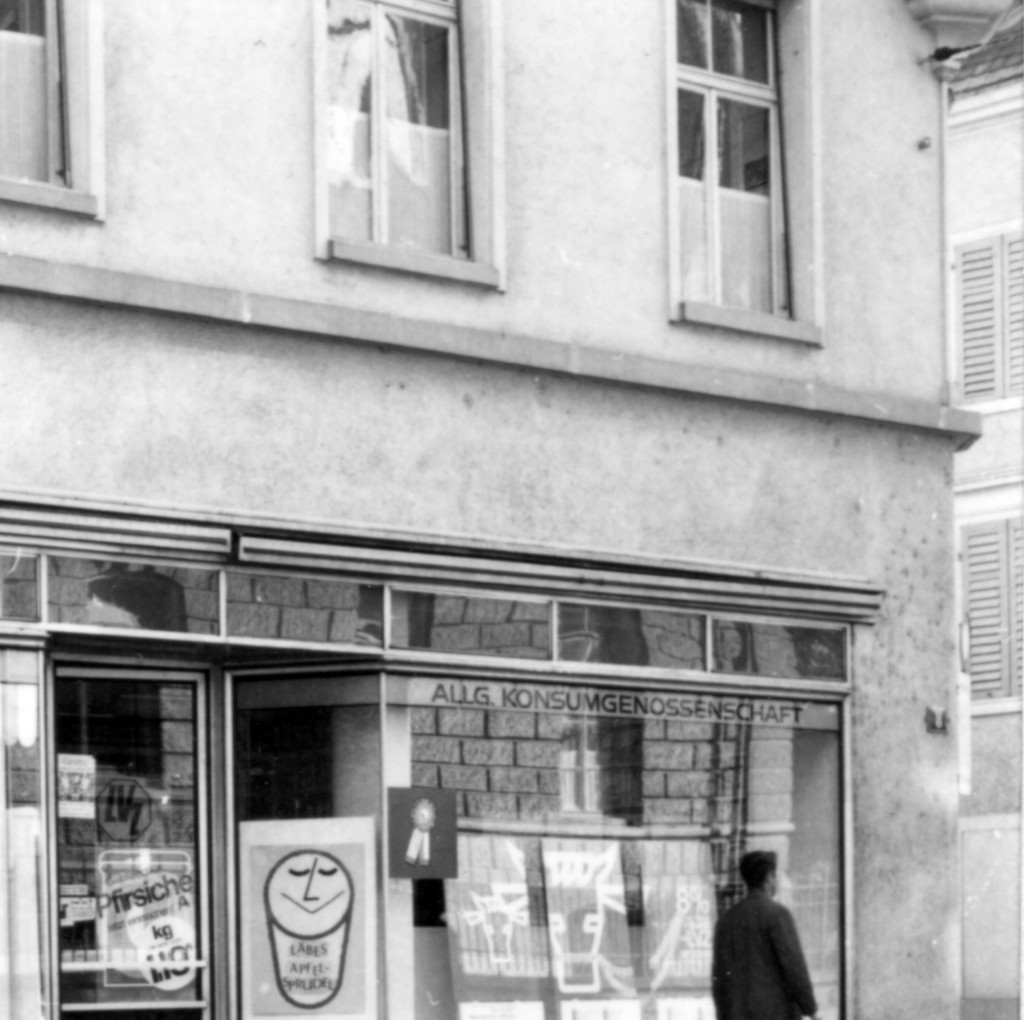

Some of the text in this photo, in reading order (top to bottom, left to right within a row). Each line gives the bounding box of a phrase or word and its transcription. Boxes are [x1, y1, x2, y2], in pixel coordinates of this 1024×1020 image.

[431, 683, 804, 723] ALLG. KONSUMGENOSSENSCHAFT
[96, 875, 193, 918] Pfirsiche
[152, 924, 173, 940] kg
